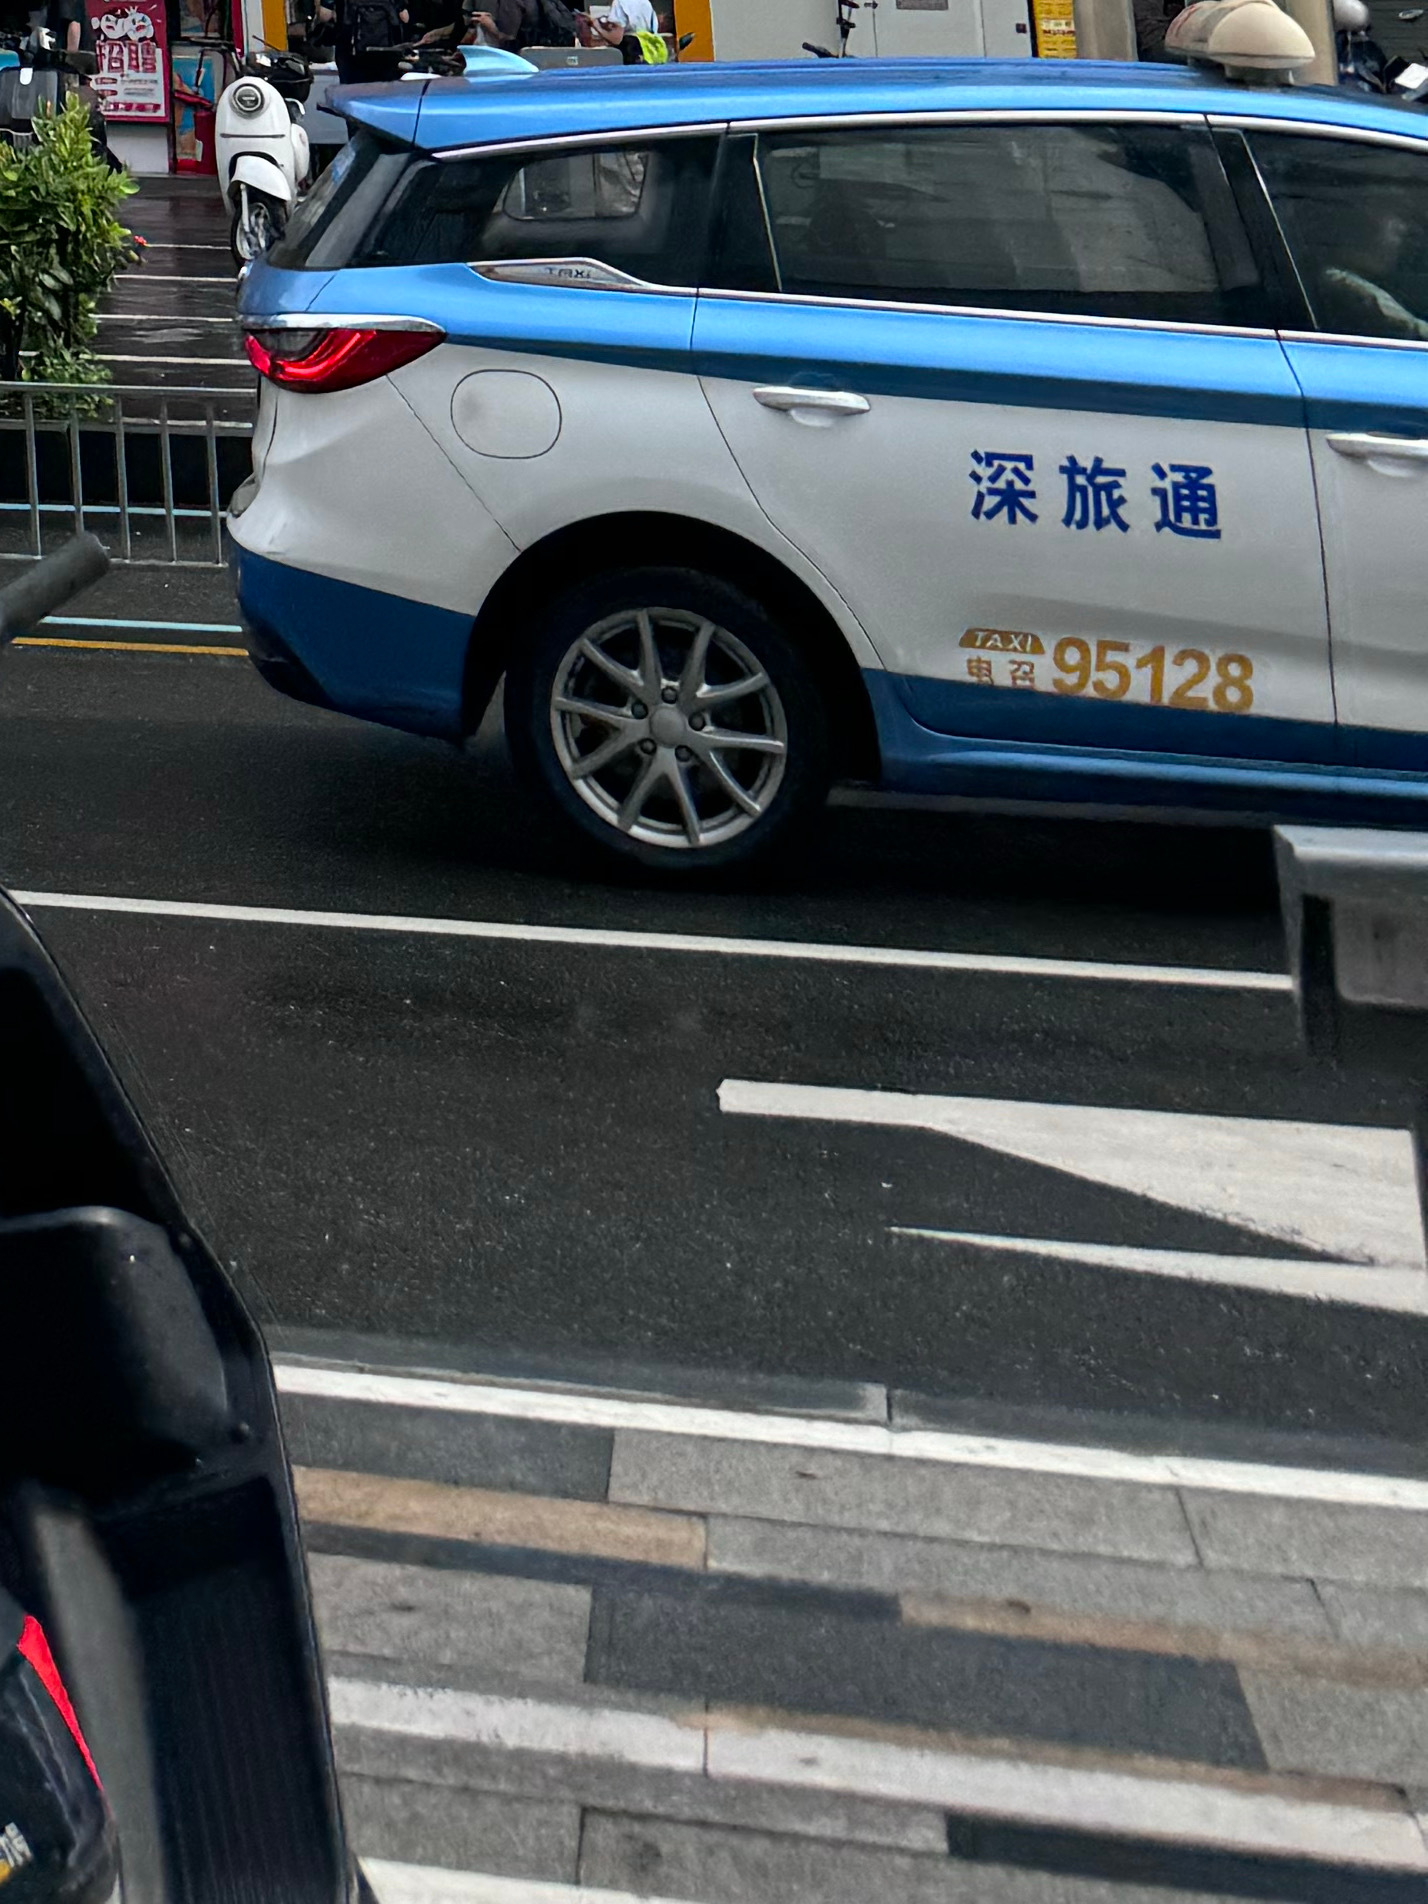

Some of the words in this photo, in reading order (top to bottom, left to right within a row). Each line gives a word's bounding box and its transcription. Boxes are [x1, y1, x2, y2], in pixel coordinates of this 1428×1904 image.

[968, 448, 1222, 540] 深旅通
[974, 631, 1034, 653] TAXI
[1052, 635, 1255, 713] 95128
